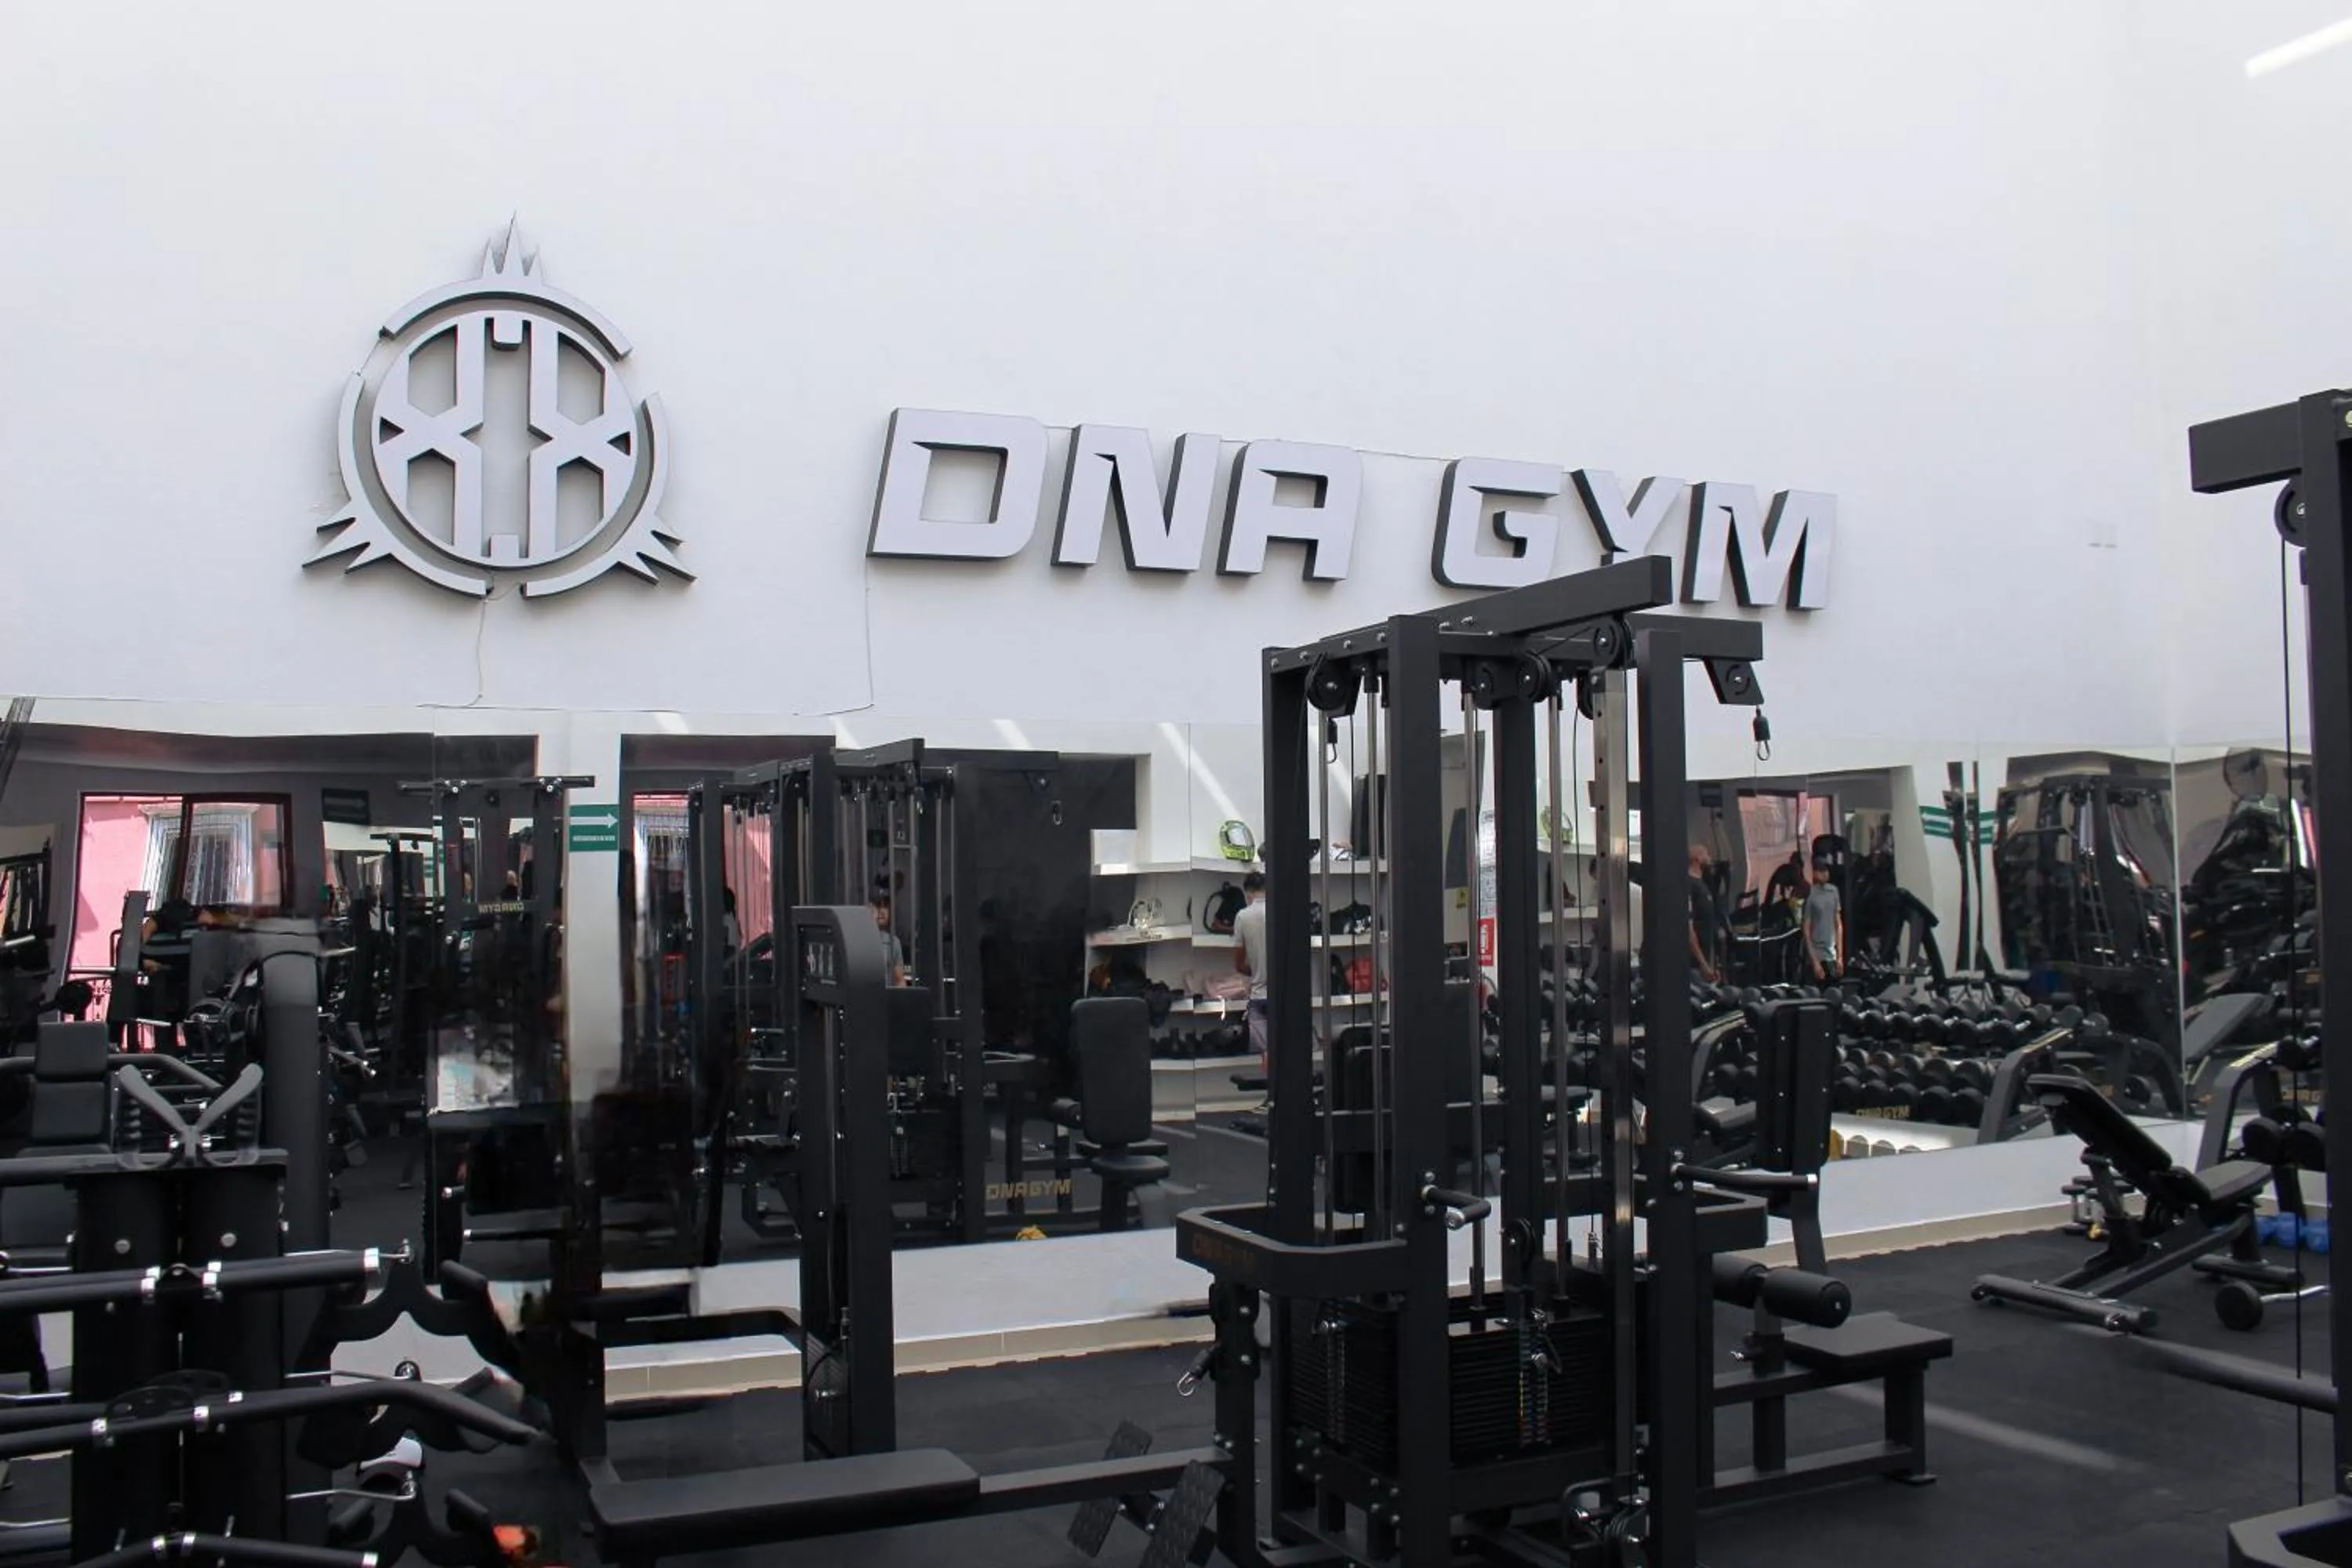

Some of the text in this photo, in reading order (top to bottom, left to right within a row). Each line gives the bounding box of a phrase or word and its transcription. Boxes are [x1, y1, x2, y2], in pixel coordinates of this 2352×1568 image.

[866, 407, 1838, 611] DNA GYM
[985, 1179, 1072, 1200] DNAGYM
